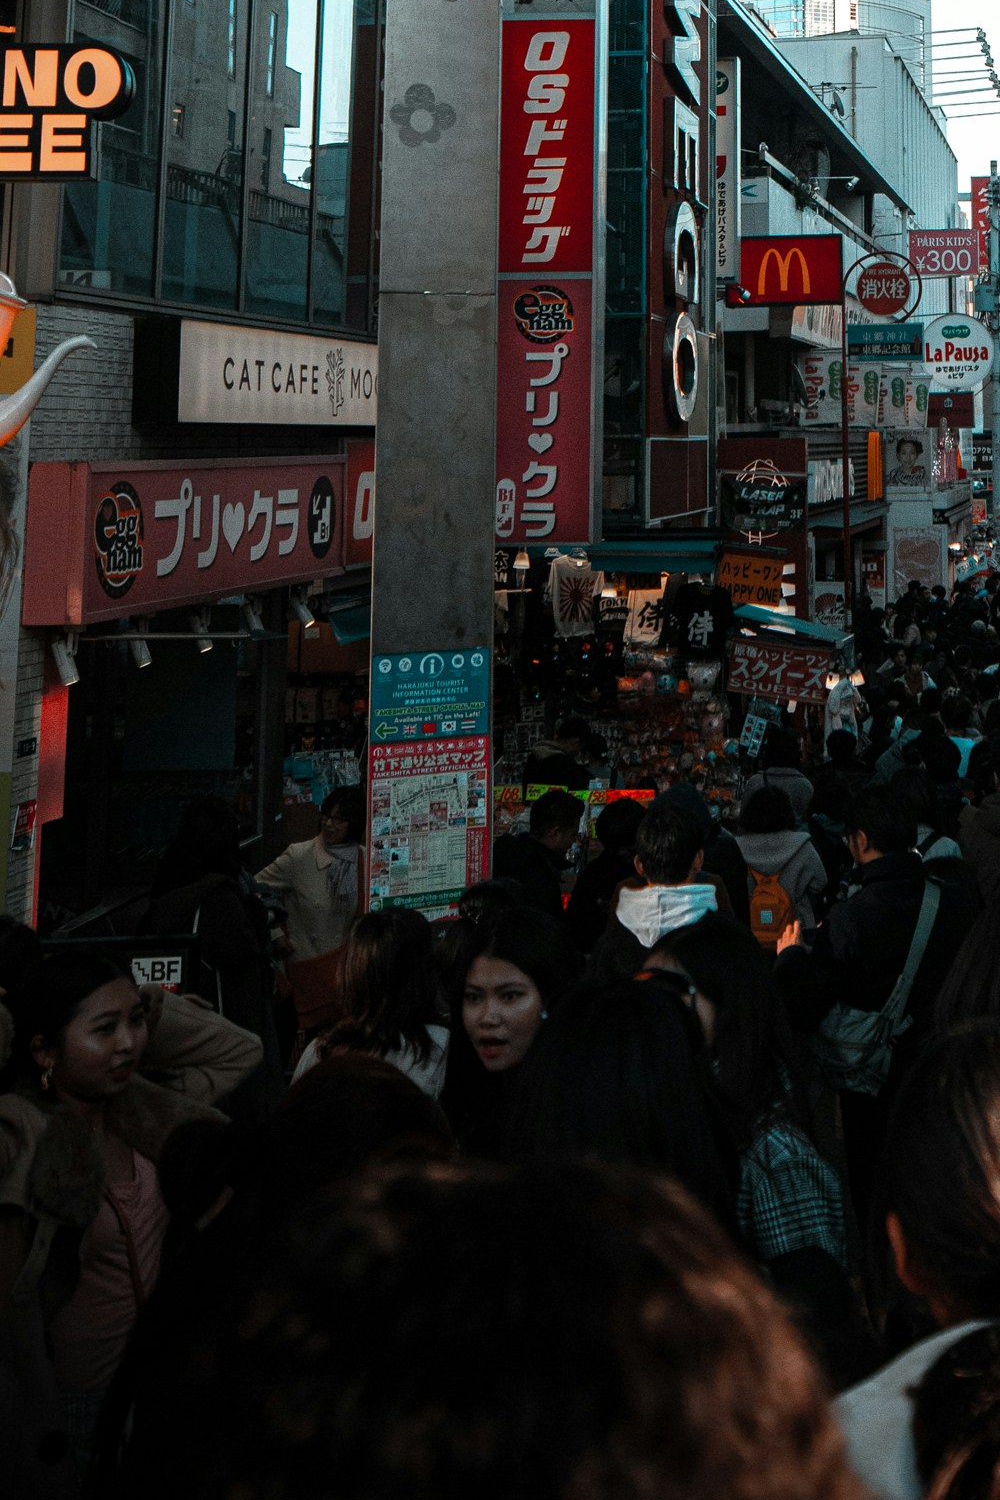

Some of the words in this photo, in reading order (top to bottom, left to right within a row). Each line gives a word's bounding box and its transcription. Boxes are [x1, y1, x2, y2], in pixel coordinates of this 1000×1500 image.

[2, 48, 122, 109] NO
[521, 31, 571, 263] OSドラッグ
[916, 236, 945, 247] PARIS
[946, 236, 972, 247] KID'S
[915, 249, 972, 273] ¥300
[861, 278, 907, 300] 消火栓
[925, 342, 942, 362] La
[945, 341, 989, 363] Pausa
[223, 357, 265, 390] CAT
[271, 362, 319, 394] CAFE
[741, 486, 785, 502] LASER
[721, 562, 781, 582] ハッピーワン
[601, 599, 628, 609] TOKY
[756, 586, 779, 603] ONE
[397, 680, 435, 690] HARAJUKU
[436, 678, 465, 687] TOURIST
[731, 656, 827, 690] スクイーズ
[392, 688, 441, 698] INFORMATION
[443, 686, 469, 694] CENTER
[729, 678, 825, 700] SQUEEZE
[373, 768, 410, 778] TAKESHITA
[412, 766, 439, 775] STREET
[440, 763, 469, 772] OFFICIAL
[471, 761, 486, 769] MAP
[150, 960, 180, 983] BF
